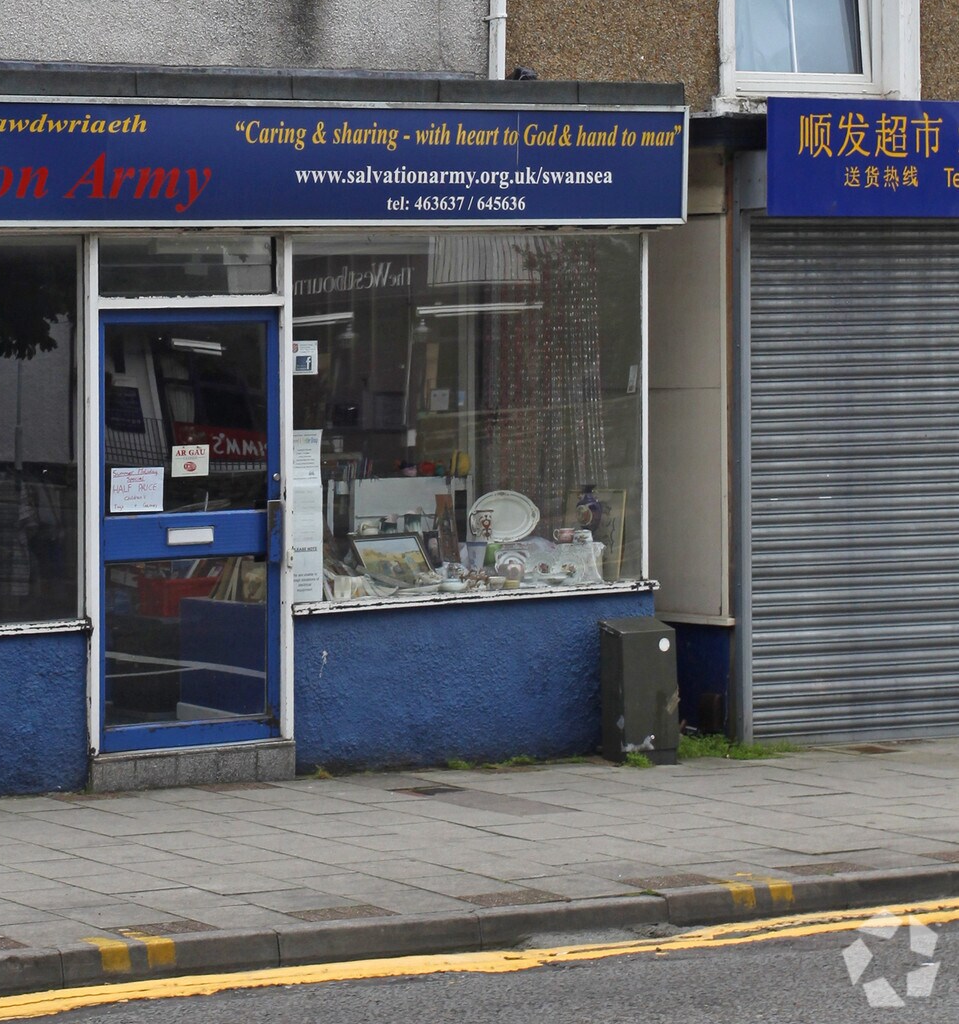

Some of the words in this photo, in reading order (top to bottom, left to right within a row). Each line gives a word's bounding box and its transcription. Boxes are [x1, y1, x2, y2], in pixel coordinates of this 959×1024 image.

[311, 121, 327, 145] &
[333, 121, 399, 151] sharing
[415, 123, 451, 145] with
[455, 123, 499, 146] heart
[503, 127, 519, 146] to
[576, 125, 617, 147] hand
[621, 129, 637, 147] to
[798, 112, 943, 158] 顺发超市
[63, 151, 212, 213] Army
[295, 165, 613, 189] www.salvationarmy.org.uk/swansea
[844, 165, 919, 192] 送货热线
[386, 196, 410, 211] tel:
[414, 196, 464, 211] 463637
[467, 196, 473, 211] /
[477, 196, 526, 211] 645636
[112, 484, 132, 494] HALF
